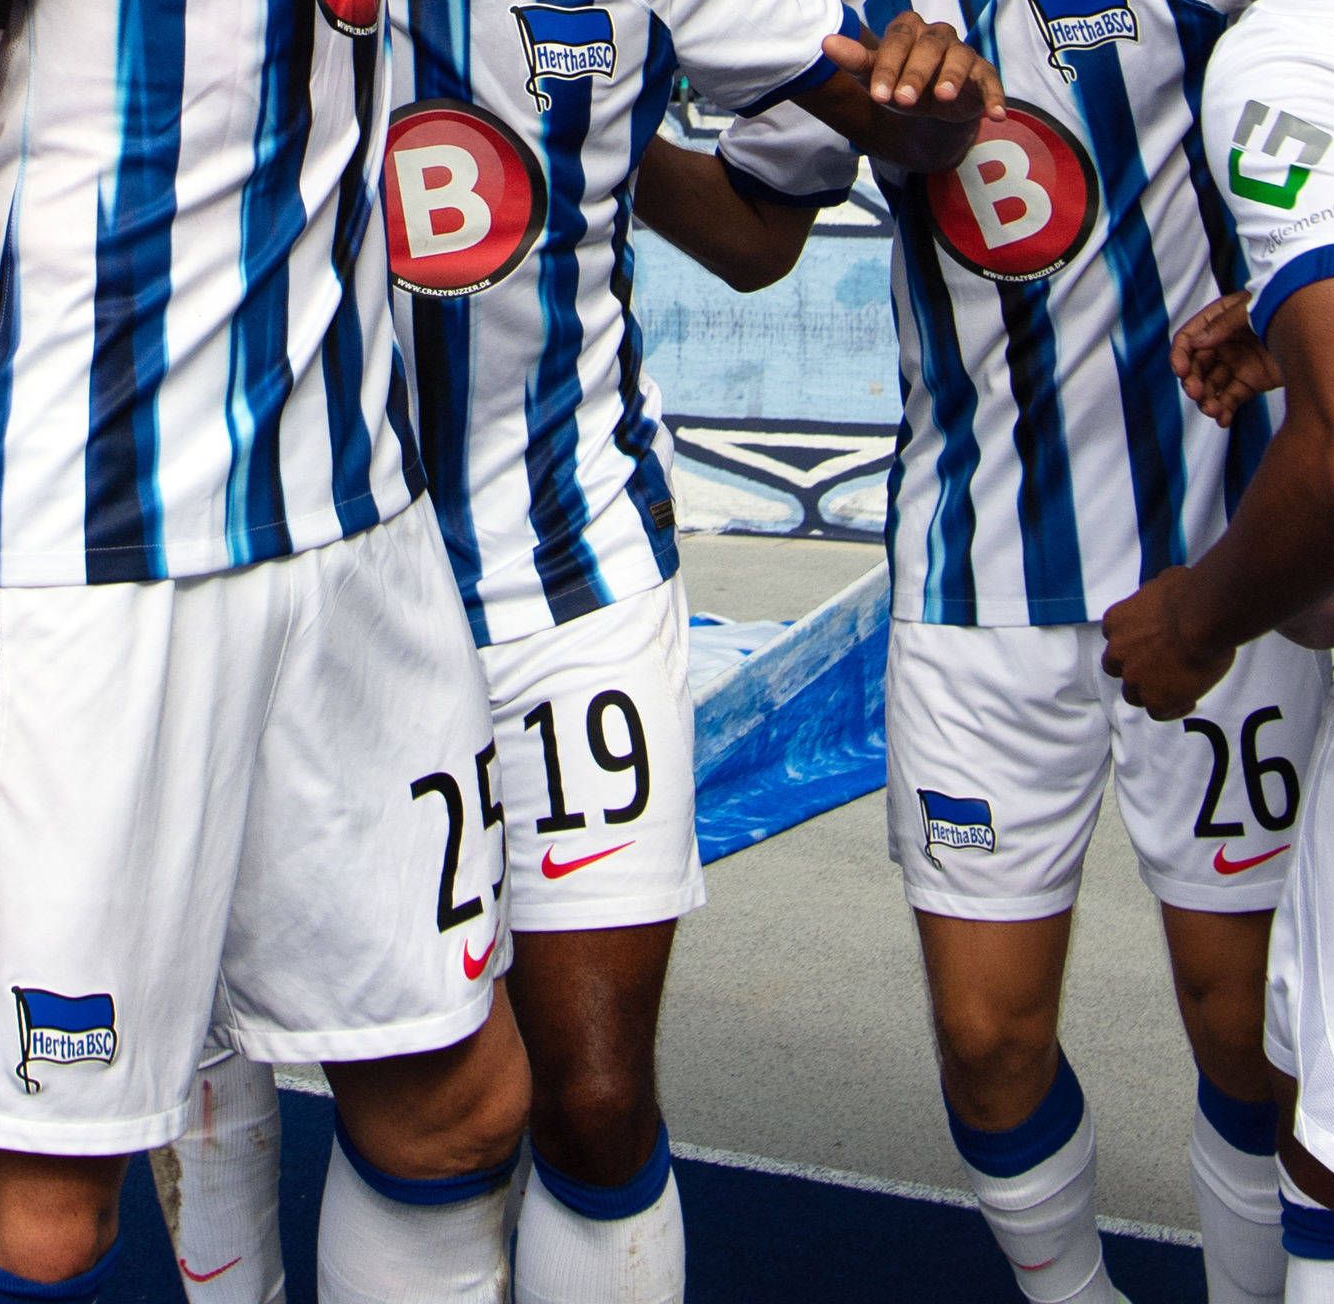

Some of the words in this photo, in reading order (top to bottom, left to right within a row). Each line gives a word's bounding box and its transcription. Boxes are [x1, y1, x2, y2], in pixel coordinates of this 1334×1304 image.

[393, 143, 492, 259] B
[955, 138, 1053, 251] B
[396, 278, 492, 297] WWW.CRAZYBUZZER.DE
[982, 258, 1066, 282] WWW.CRAZYBUZZER.DE
[523, 689, 650, 835] 19
[1183, 705, 1300, 839] 26
[409, 741, 504, 934] 25
